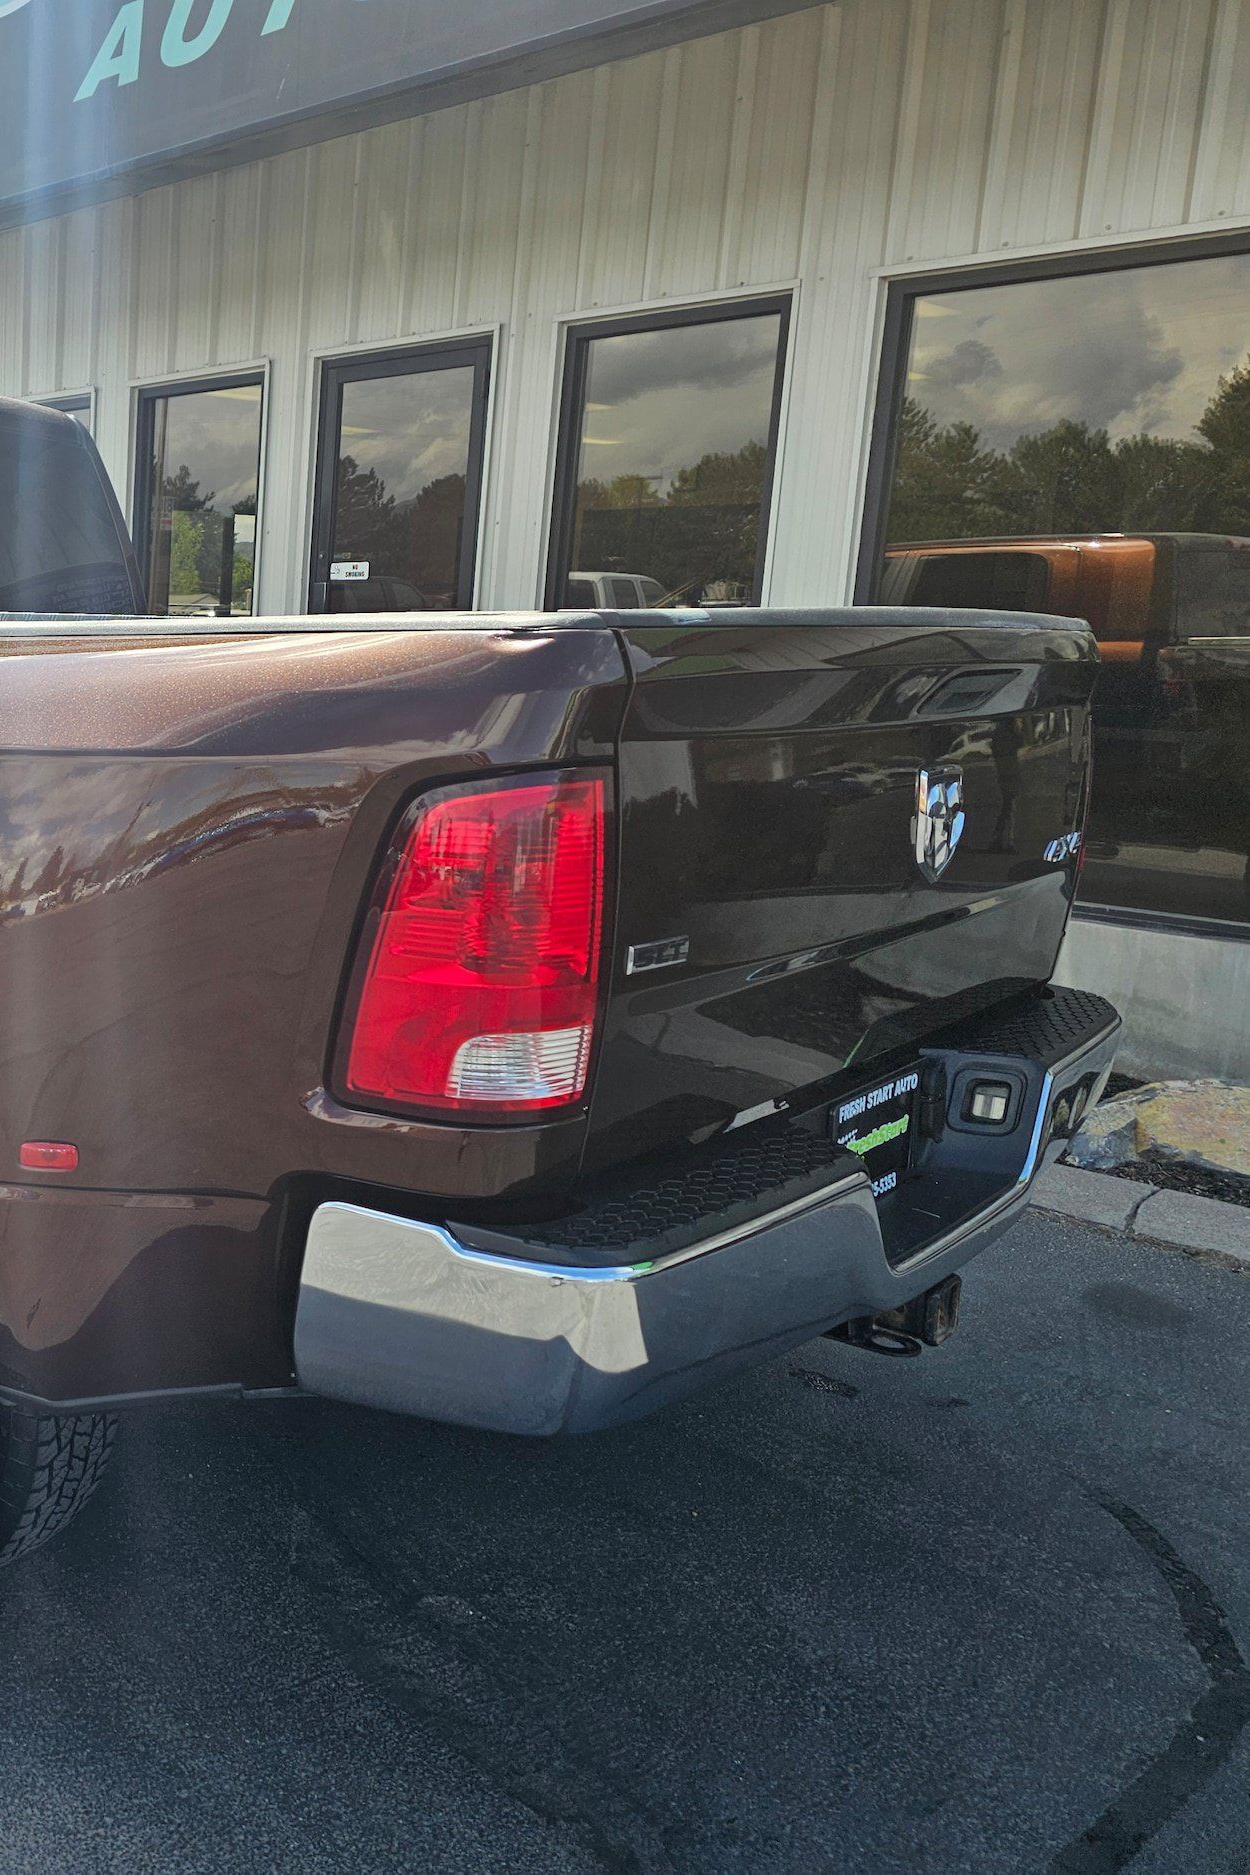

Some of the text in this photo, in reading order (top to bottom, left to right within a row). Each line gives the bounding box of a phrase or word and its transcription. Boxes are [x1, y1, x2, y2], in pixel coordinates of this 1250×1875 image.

[838, 1072, 919, 1124] FRESH START AUTO
